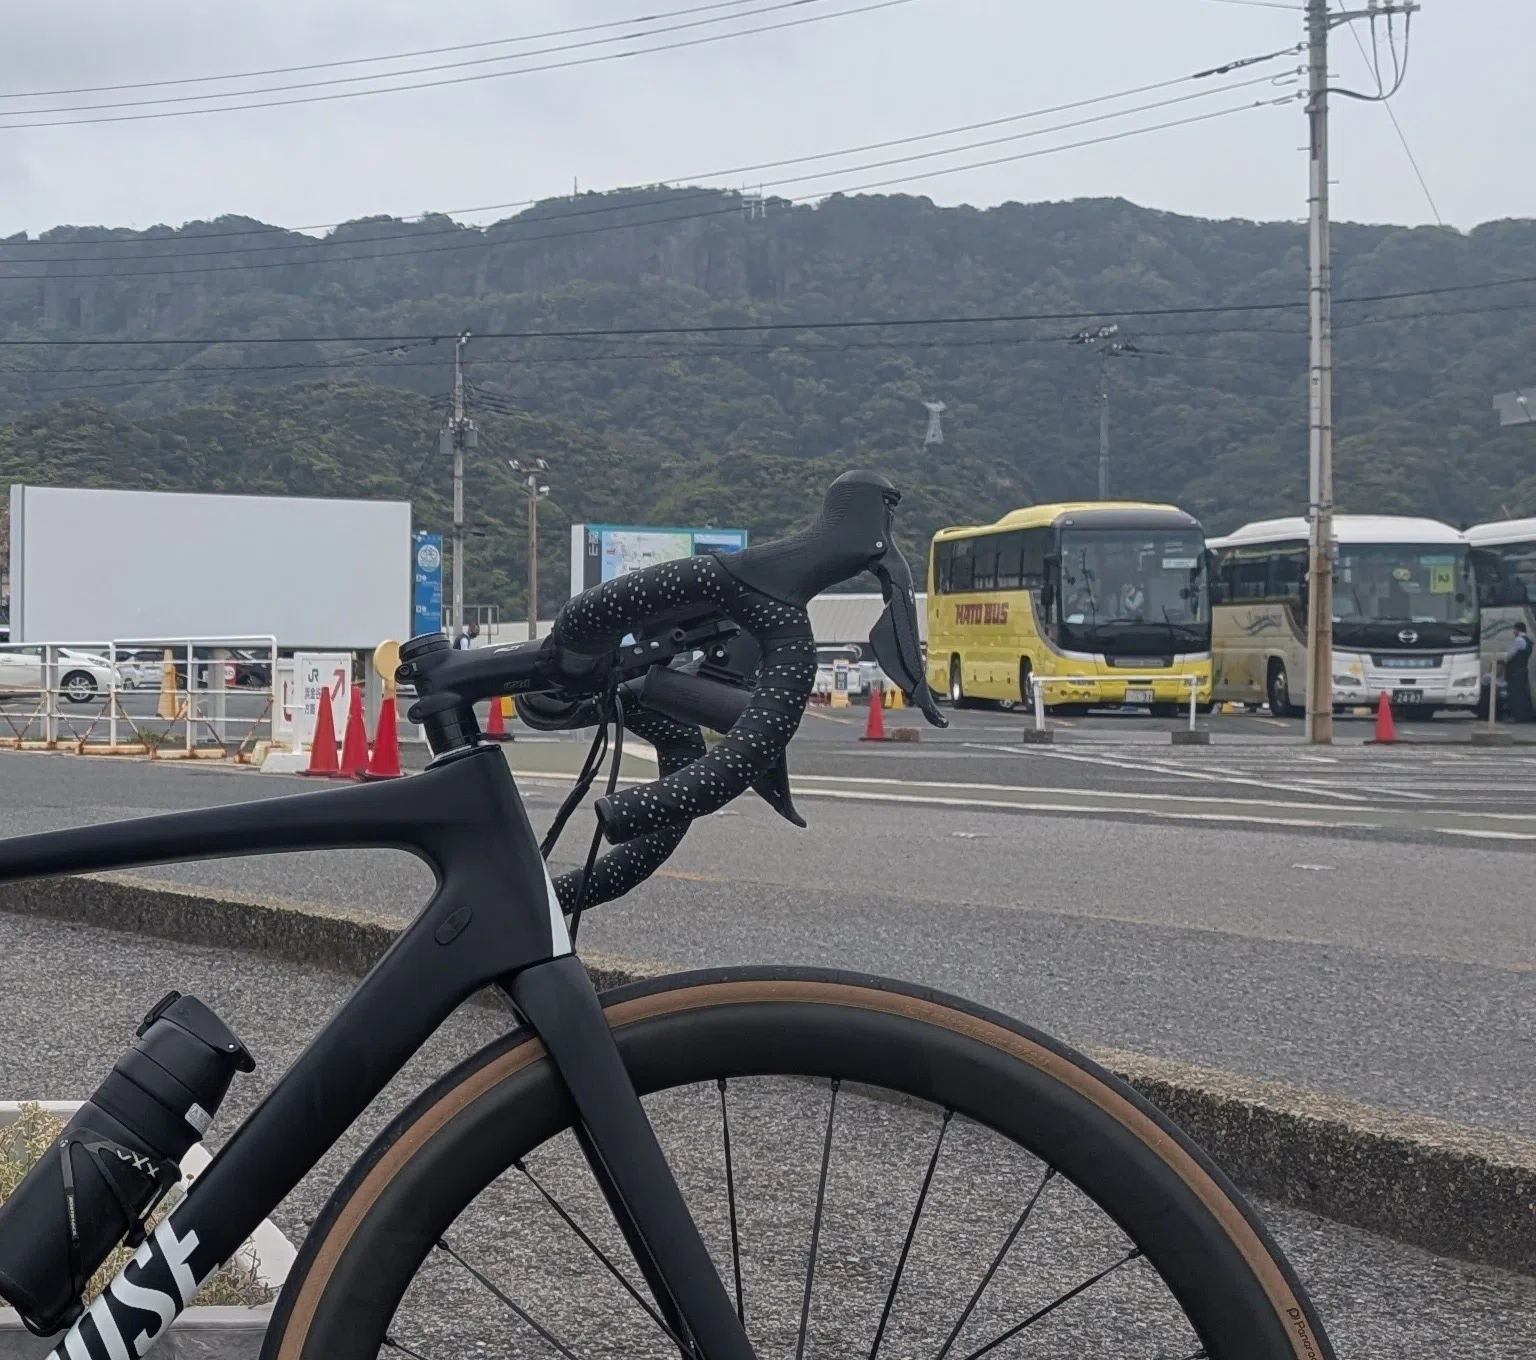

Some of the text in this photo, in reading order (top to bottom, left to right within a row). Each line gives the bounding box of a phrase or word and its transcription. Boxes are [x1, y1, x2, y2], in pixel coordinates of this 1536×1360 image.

[955, 602, 1010, 625] HATO BUS
[307, 668, 320, 683] JR
